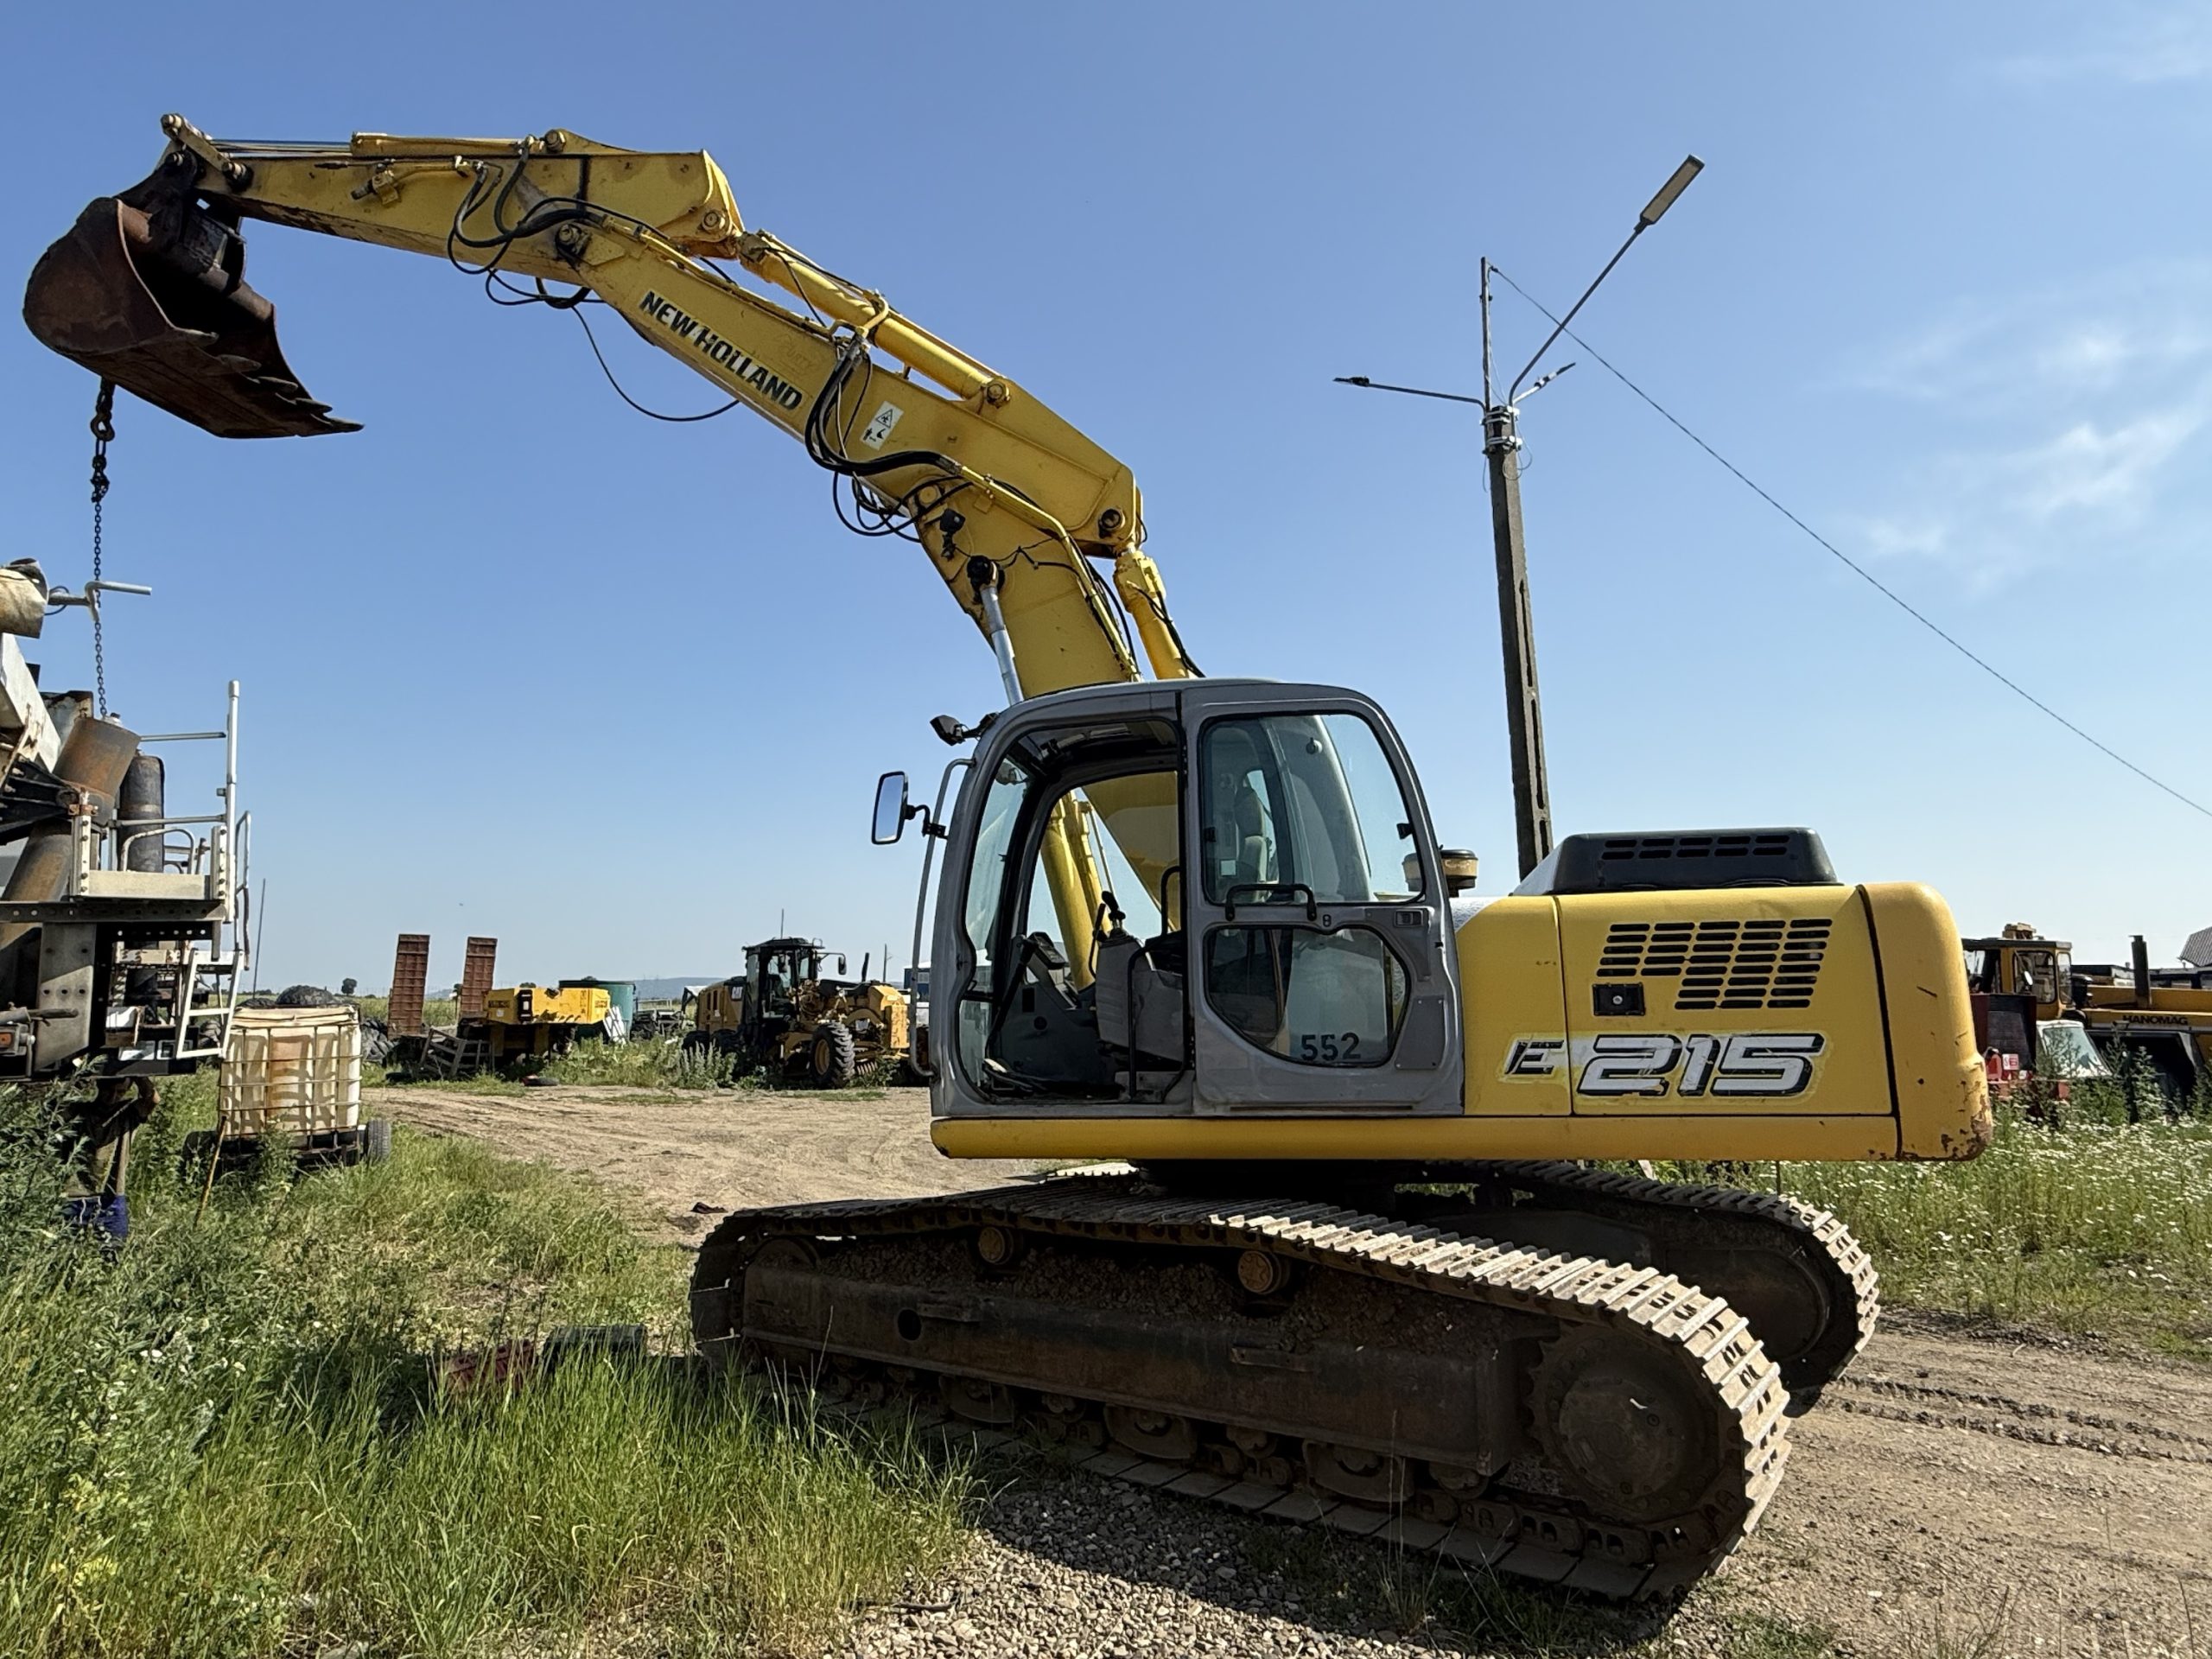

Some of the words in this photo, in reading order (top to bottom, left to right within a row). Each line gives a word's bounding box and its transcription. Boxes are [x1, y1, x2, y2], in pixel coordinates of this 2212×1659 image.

[639, 290, 699, 338] NEW
[692, 326, 803, 410] HOLLAND
[2123, 1014, 2188, 1025] HANOMAG
[1300, 1033, 1361, 1061] 552
[1503, 1039, 1564, 1075] E
[1576, 1033, 1825, 1096] 215
